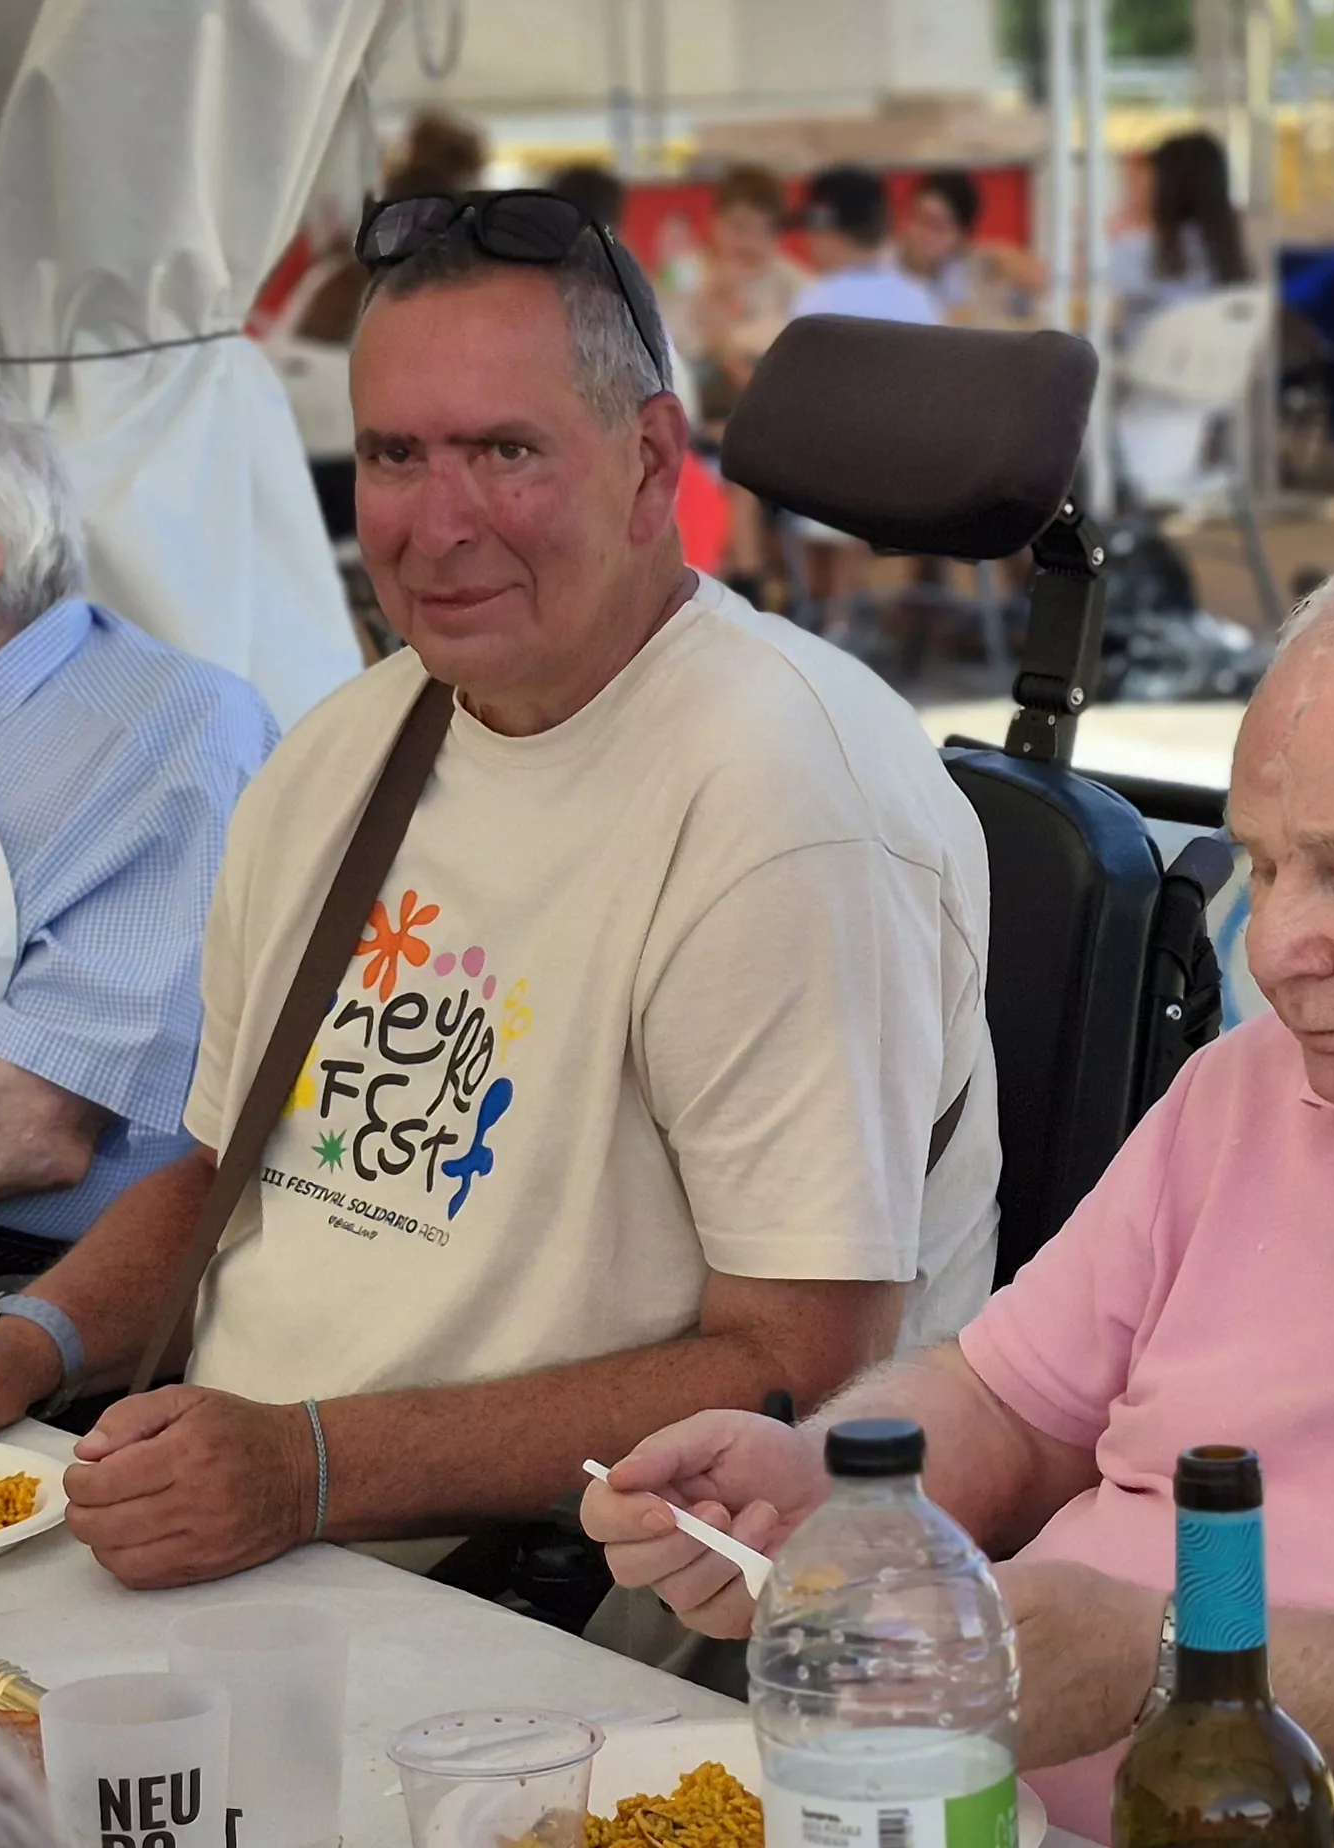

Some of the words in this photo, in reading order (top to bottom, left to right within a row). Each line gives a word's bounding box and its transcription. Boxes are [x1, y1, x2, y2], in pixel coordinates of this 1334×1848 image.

[286, 1176, 347, 1208] FESTIVAL
[347, 1198, 418, 1234] SOLIDARIO
[98, 1768, 201, 1832] NEU
